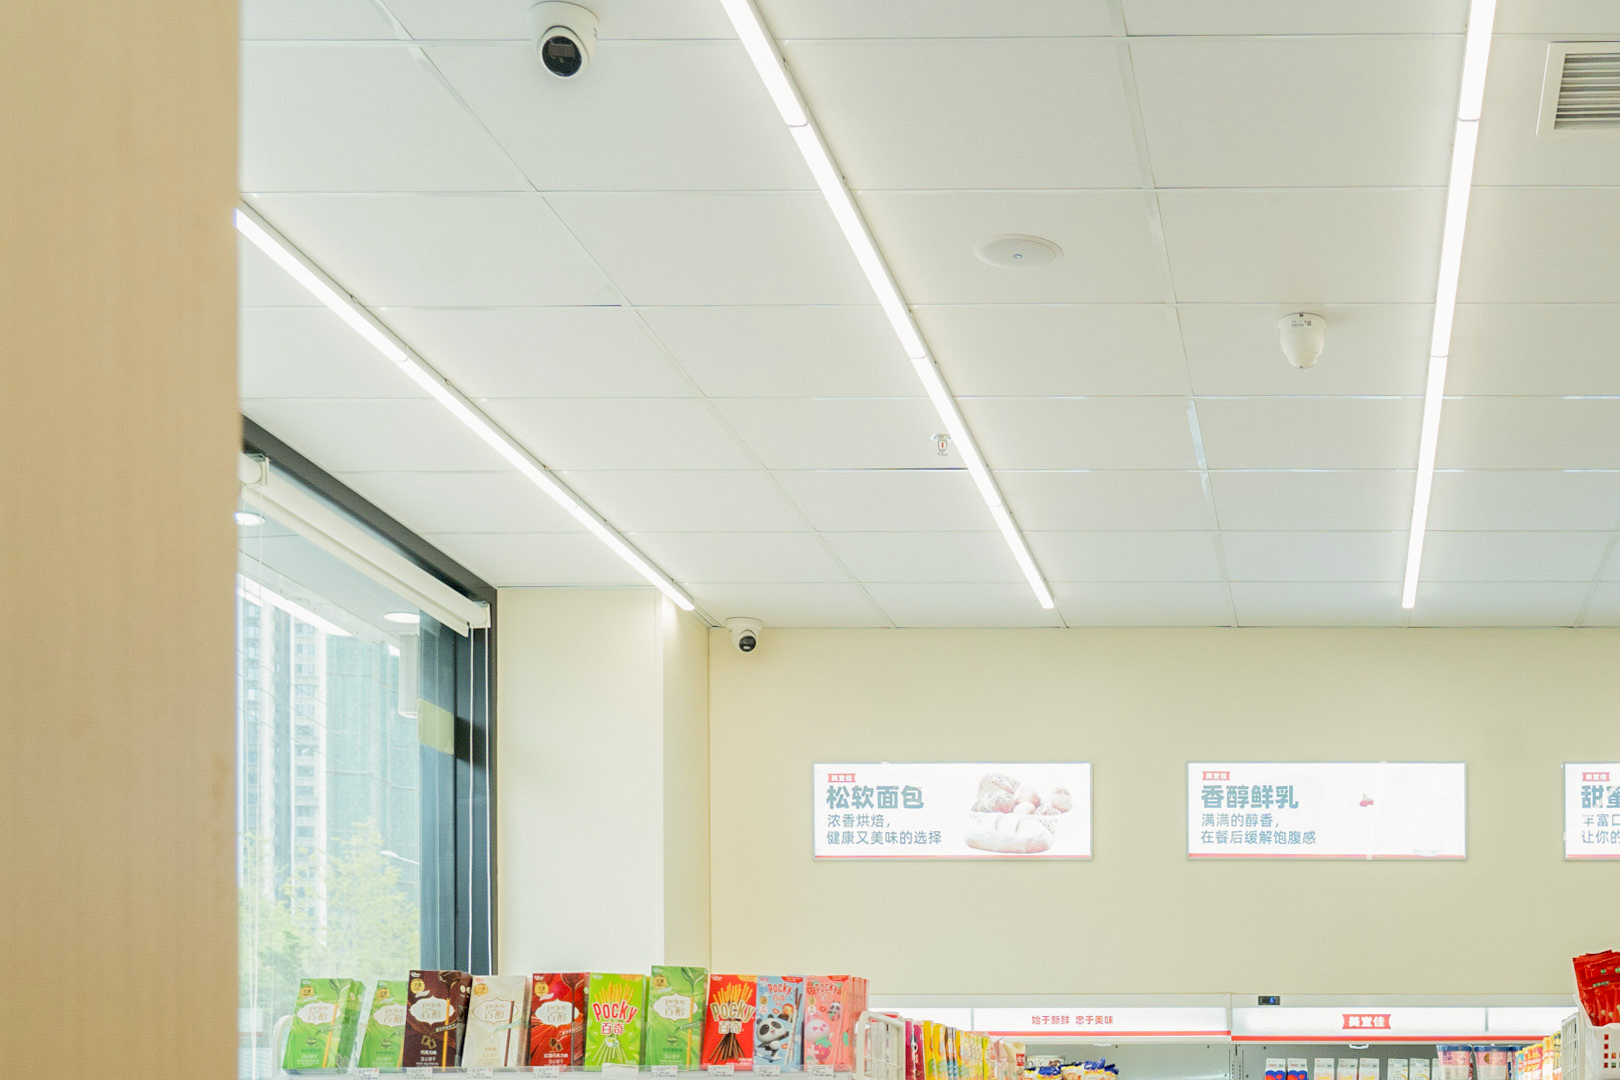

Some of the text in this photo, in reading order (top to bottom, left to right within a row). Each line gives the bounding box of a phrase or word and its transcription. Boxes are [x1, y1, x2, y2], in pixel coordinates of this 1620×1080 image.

[826, 785, 924, 809] 松软面包
[1201, 785, 1299, 809] 香醇鲜乳
[826, 830, 942, 845] 健康又美味的选择
[1200, 830, 1316, 845] 在餐后缓解饱腹感
[718, 1020, 742, 1034] 百奇
[1031, 1015, 1114, 1025] 始于新鲜 忠于美味
[1348, 1016, 1386, 1028] 美宜佳
[601, 1022, 625, 1036] 百奇
